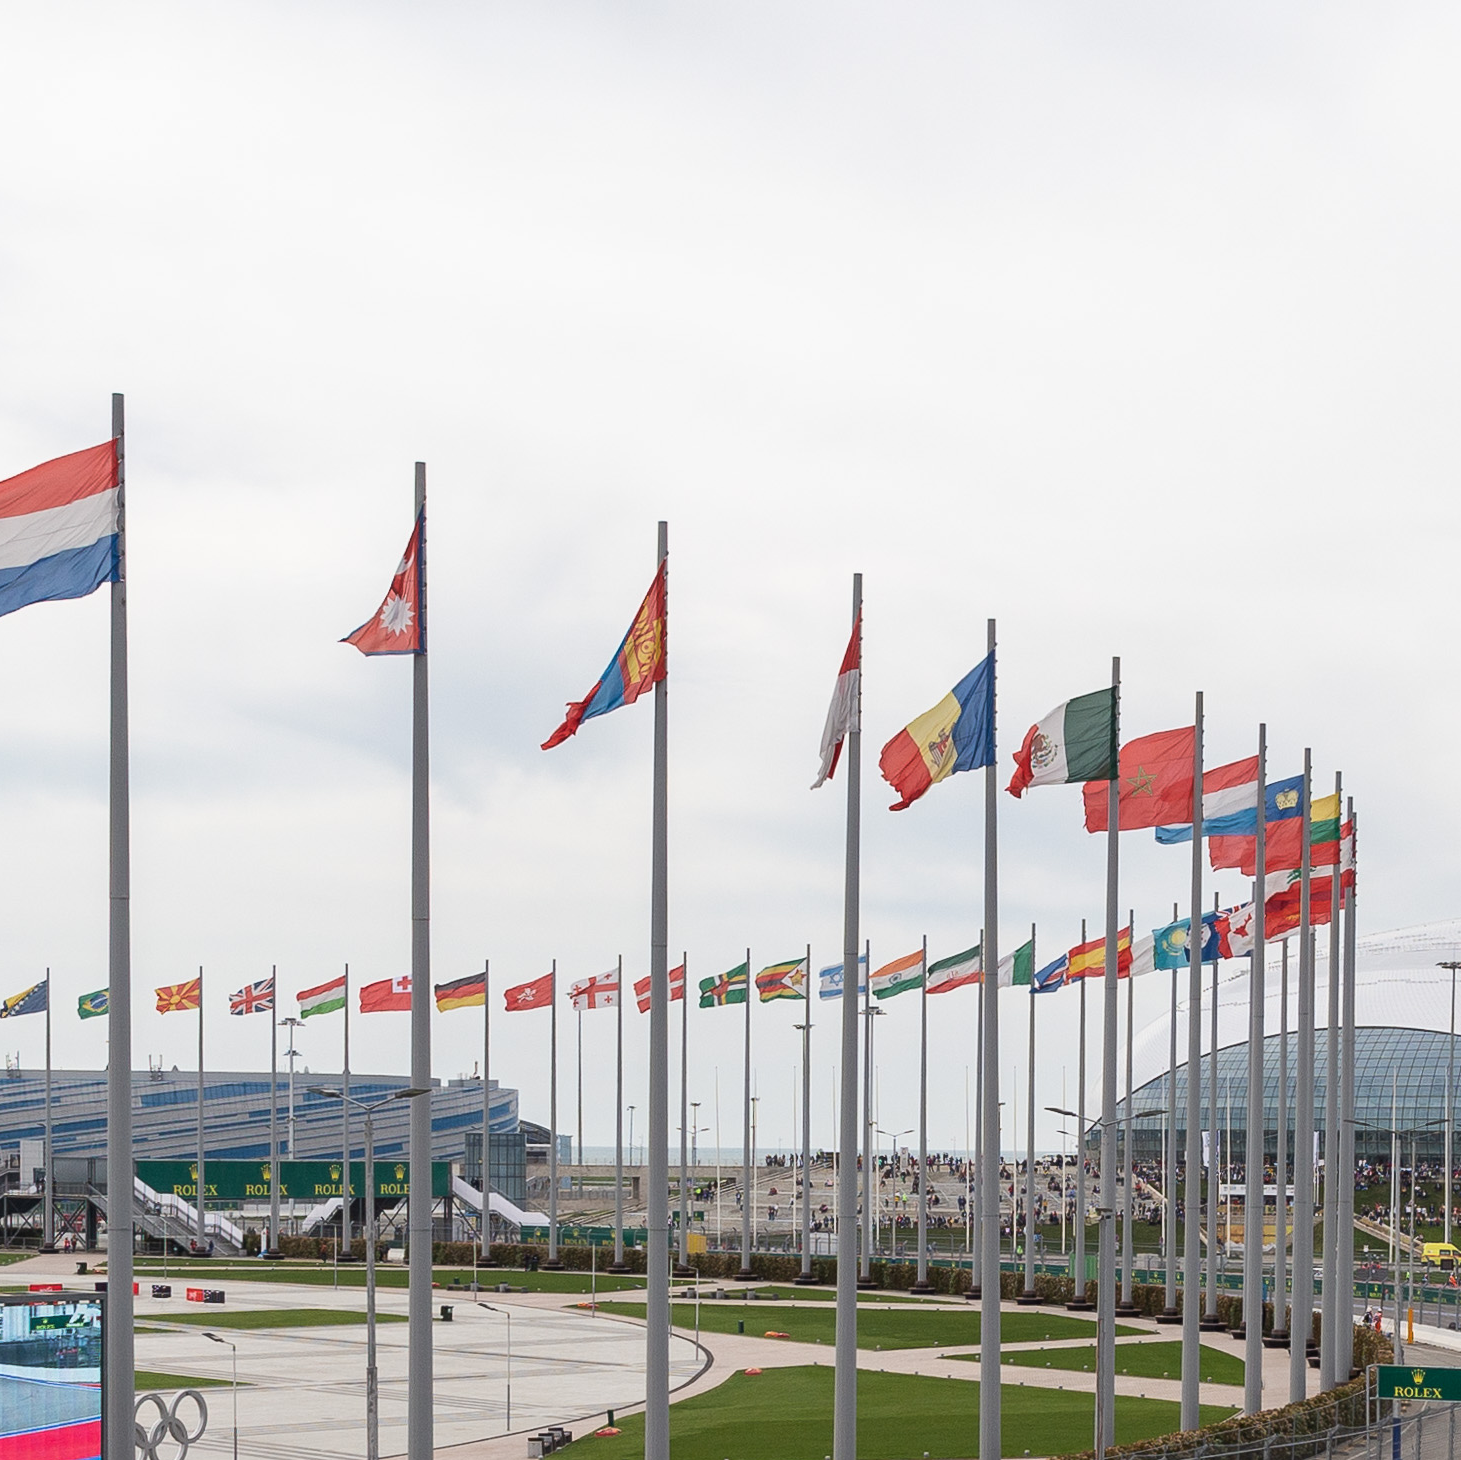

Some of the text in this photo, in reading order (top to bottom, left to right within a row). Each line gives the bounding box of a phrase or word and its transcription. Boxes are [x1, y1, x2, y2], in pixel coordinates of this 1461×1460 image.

[245, 1184, 288, 1196] ROLX
[380, 1183, 410, 1195] ROLE
[1394, 1386, 1442, 1399] ROLEX
